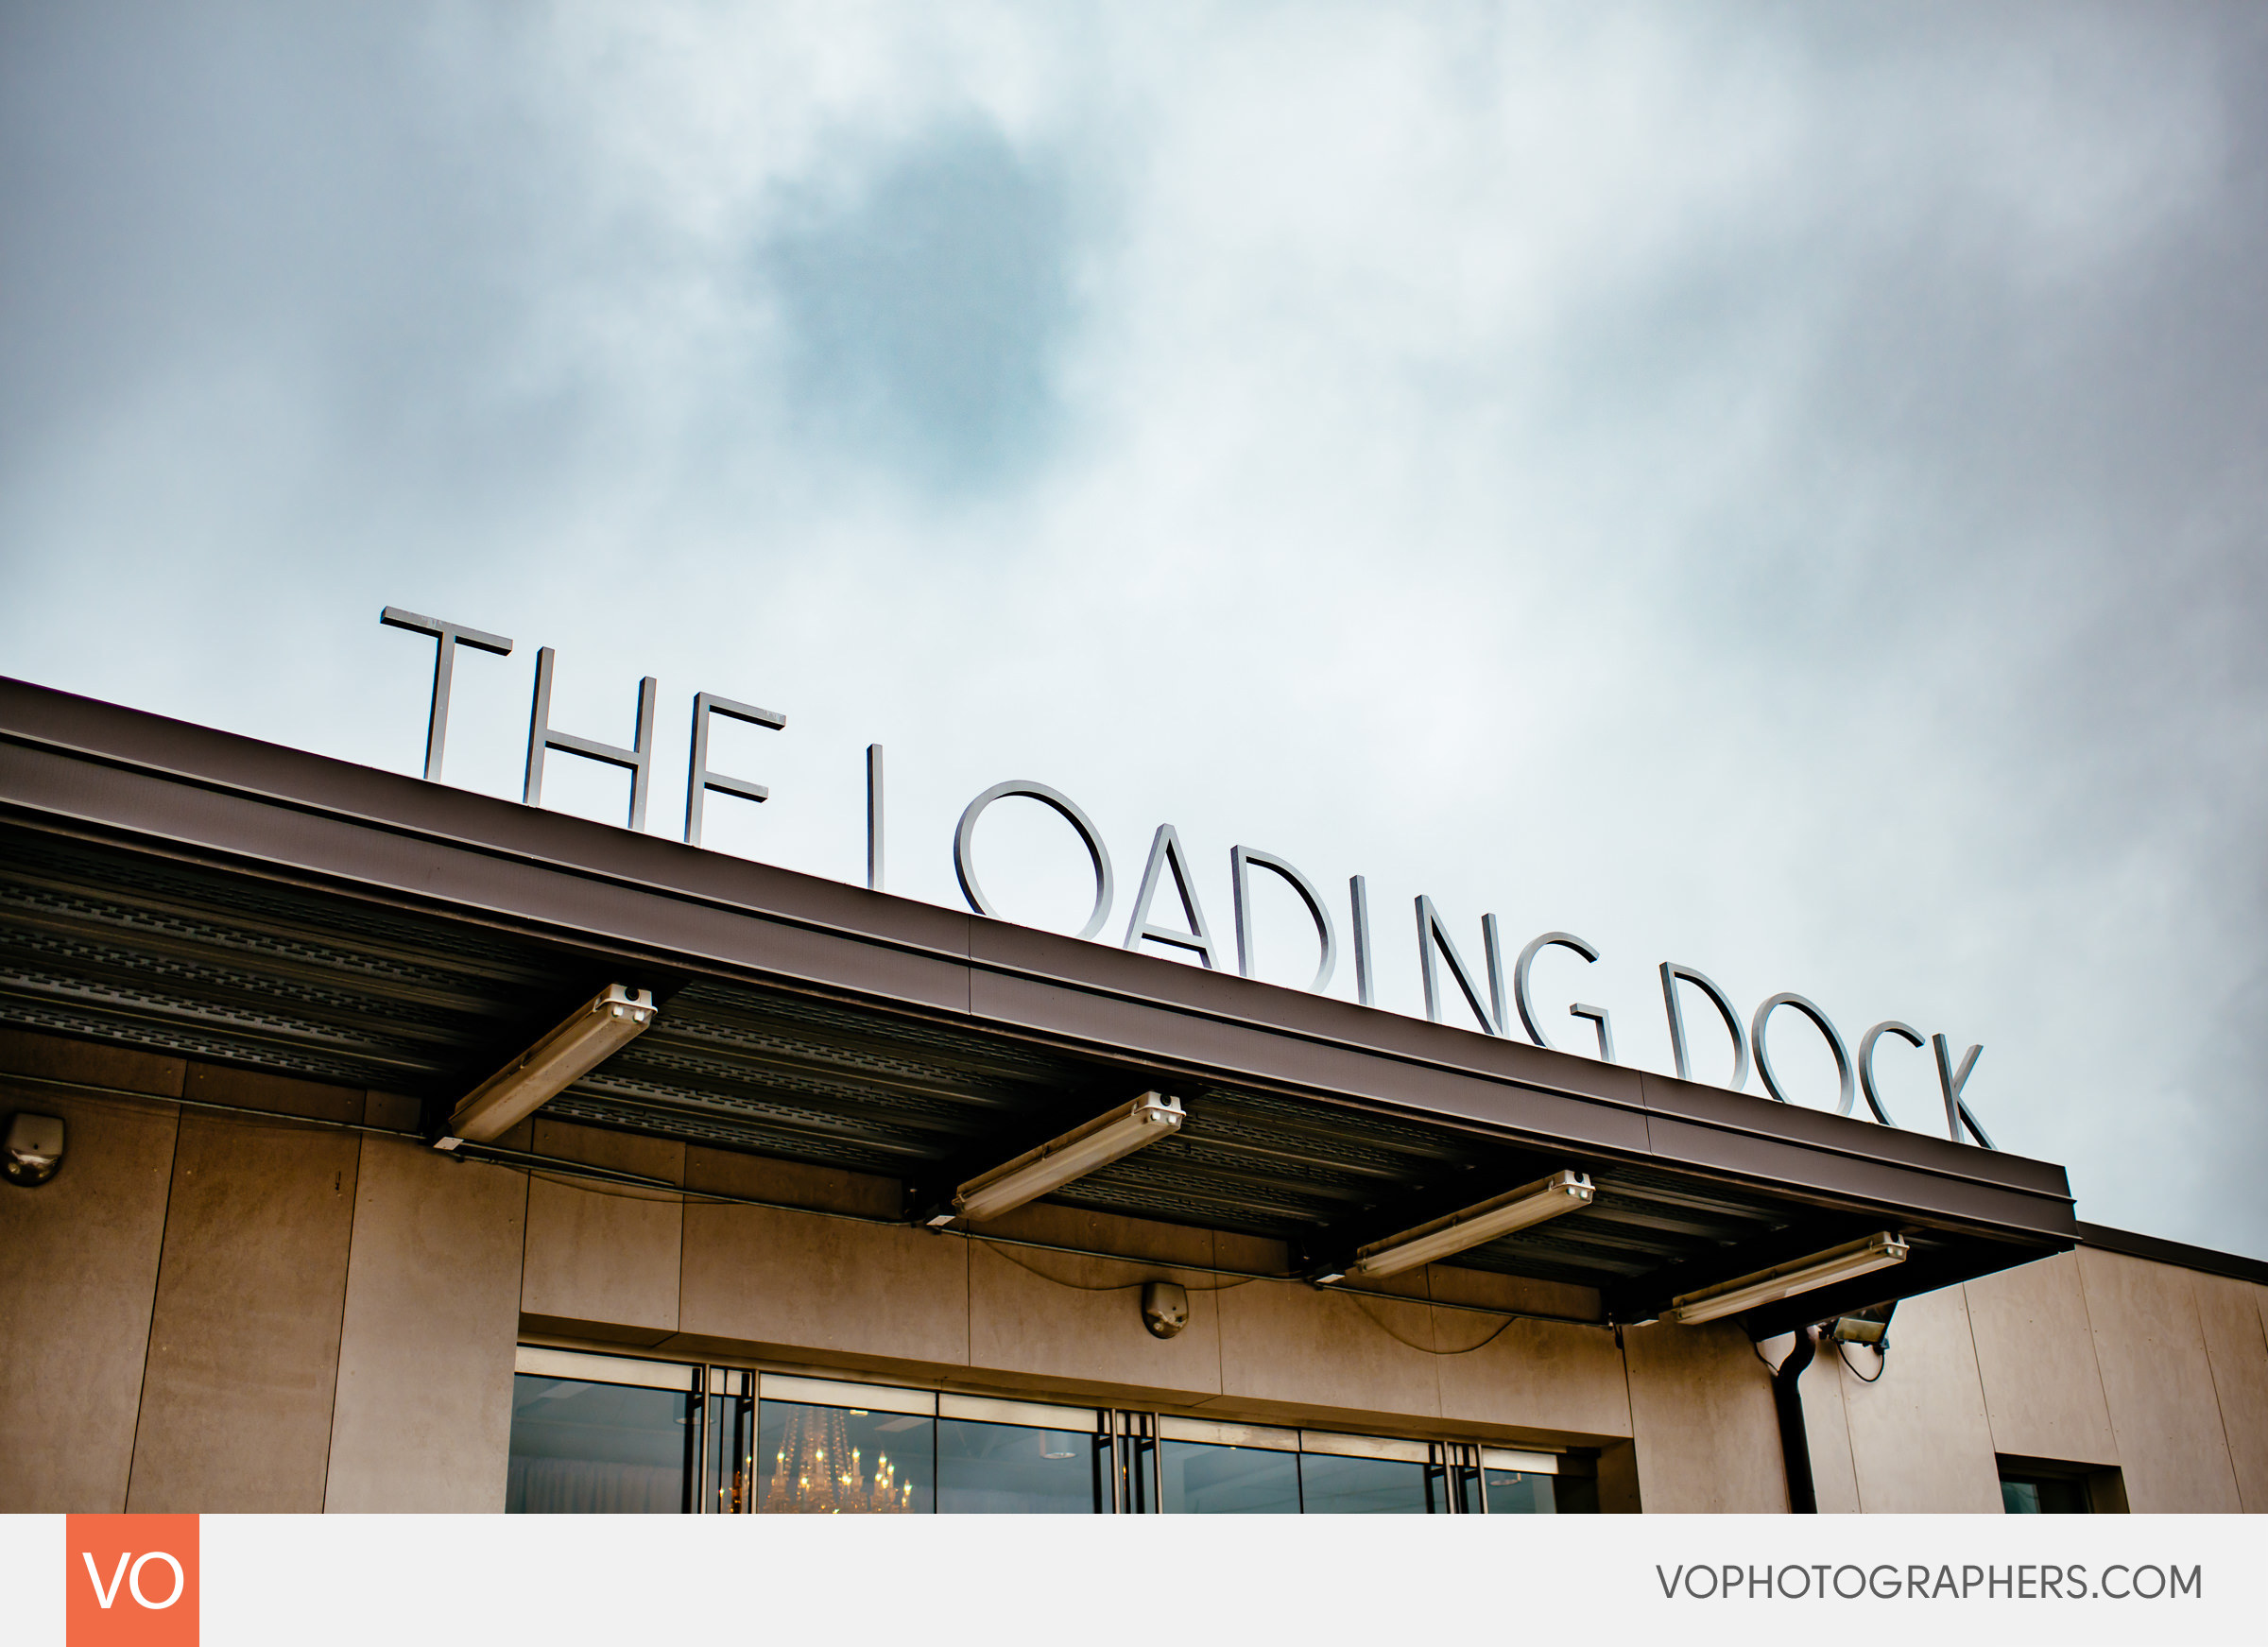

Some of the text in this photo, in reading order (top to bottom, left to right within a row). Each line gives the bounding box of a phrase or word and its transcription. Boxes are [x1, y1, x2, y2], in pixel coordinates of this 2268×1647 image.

[380, 606, 1999, 1152] THE LOADING DOCK
